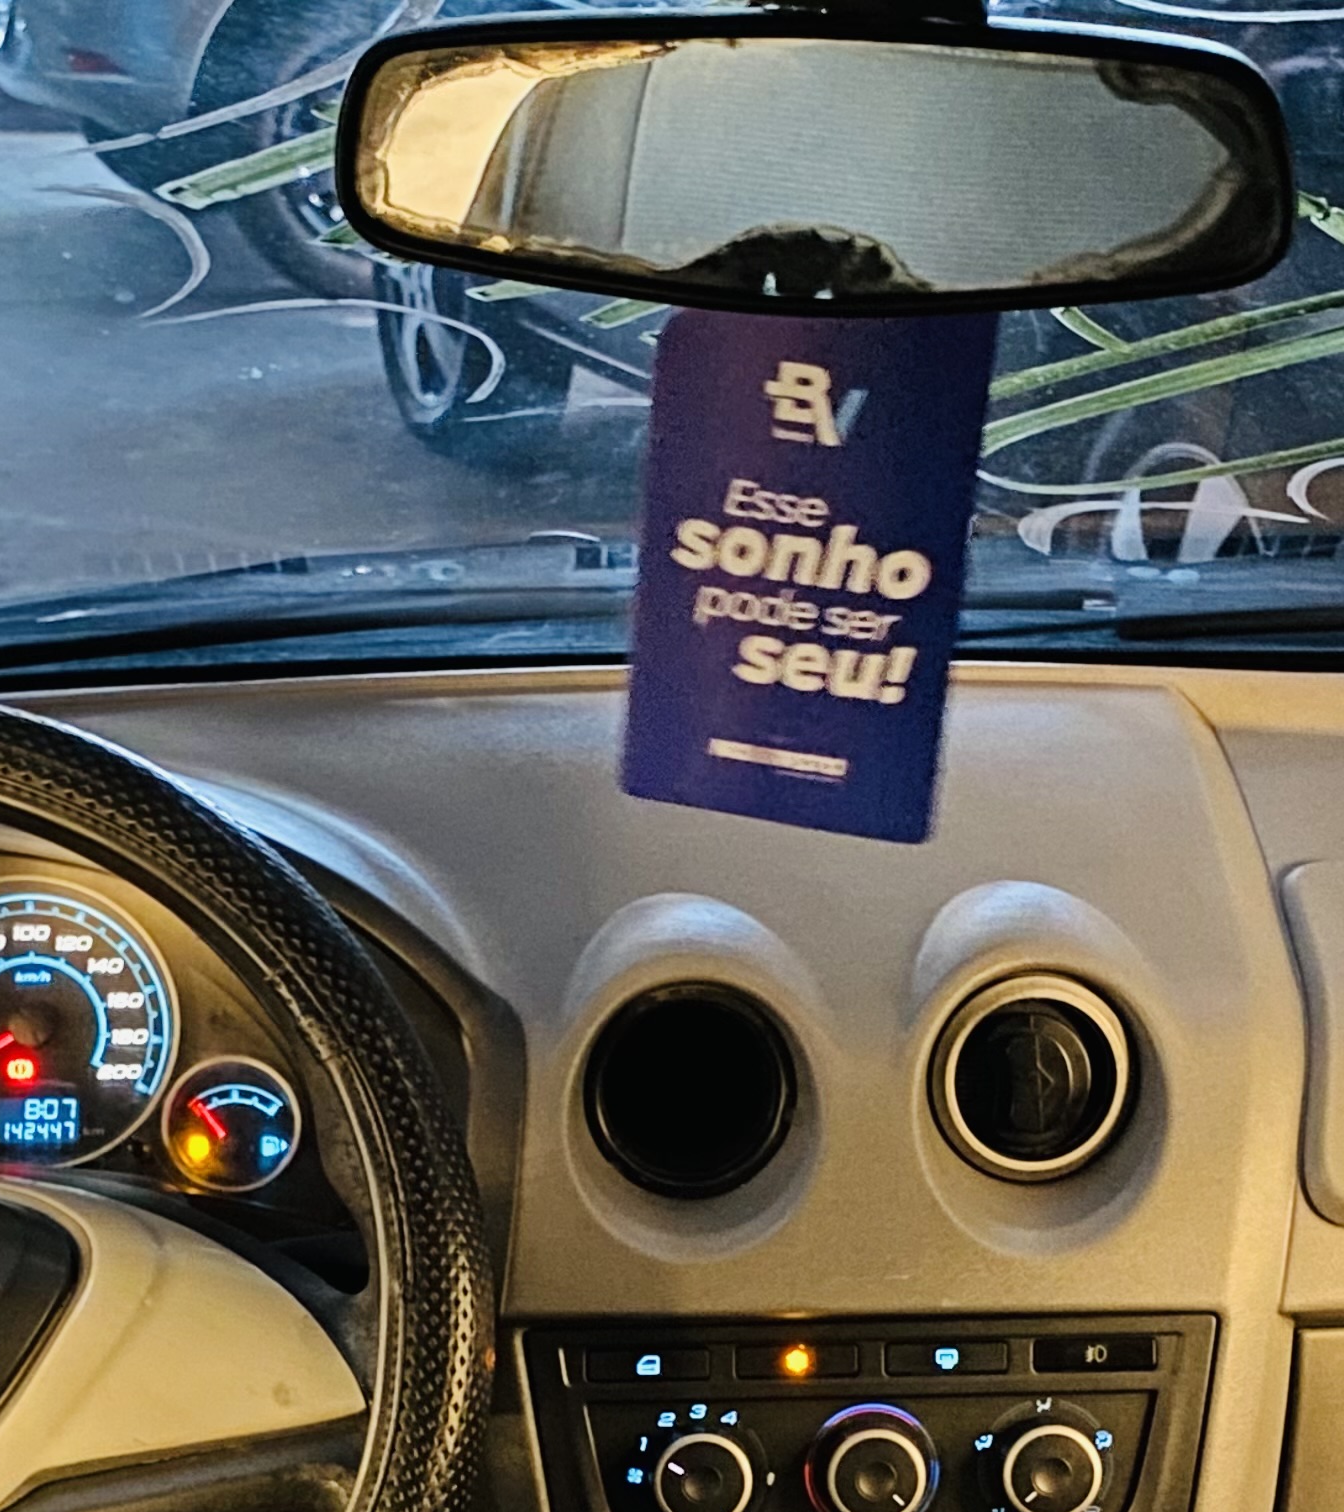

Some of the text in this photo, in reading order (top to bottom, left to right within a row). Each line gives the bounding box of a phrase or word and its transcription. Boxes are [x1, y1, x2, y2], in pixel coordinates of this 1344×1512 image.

[722, 478, 830, 528] Esse
[668, 518, 933, 601] sonho
[692, 584, 903, 642] pode ser
[730, 634, 919, 705] seu!
[12, 924, 51, 941] 100
[55, 935, 93, 952] 120
[86, 957, 125, 974] 140
[96, 1064, 143, 1080] 200
[23, 1098, 78, 1120] 8:07
[3, 1121, 77, 1141] 142447
[657, 1411, 677, 1428] 2
[689, 1404, 707, 1419] 3
[720, 1410, 739, 1425] 4
[639, 1436, 648, 1452] 1
